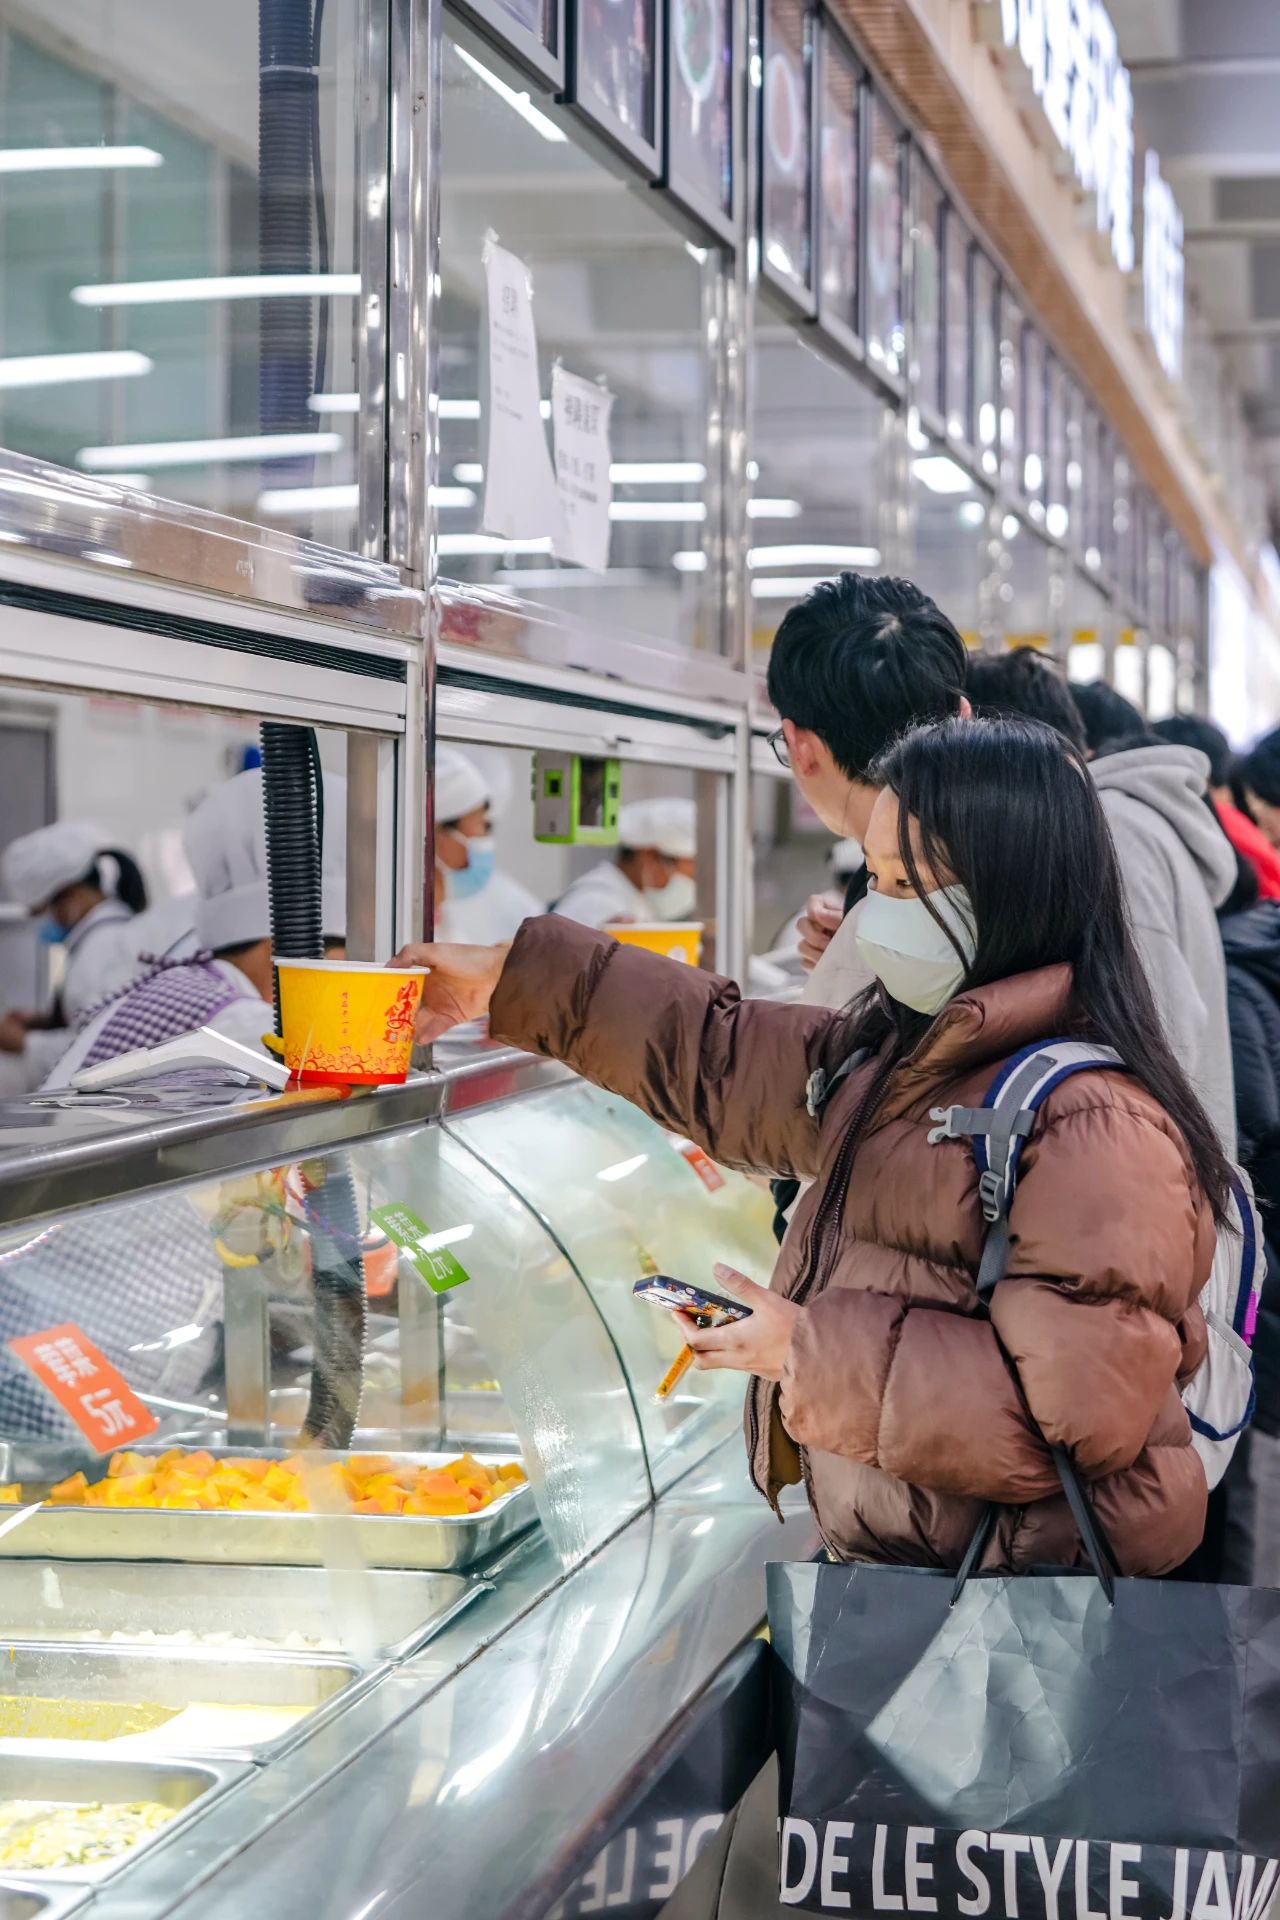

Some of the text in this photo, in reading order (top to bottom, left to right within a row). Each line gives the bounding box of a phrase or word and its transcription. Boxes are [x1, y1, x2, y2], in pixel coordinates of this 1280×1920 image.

[79, 1387, 136, 1437] 5元
[779, 1816, 1280, 1920] DE LE STYLE JAM
